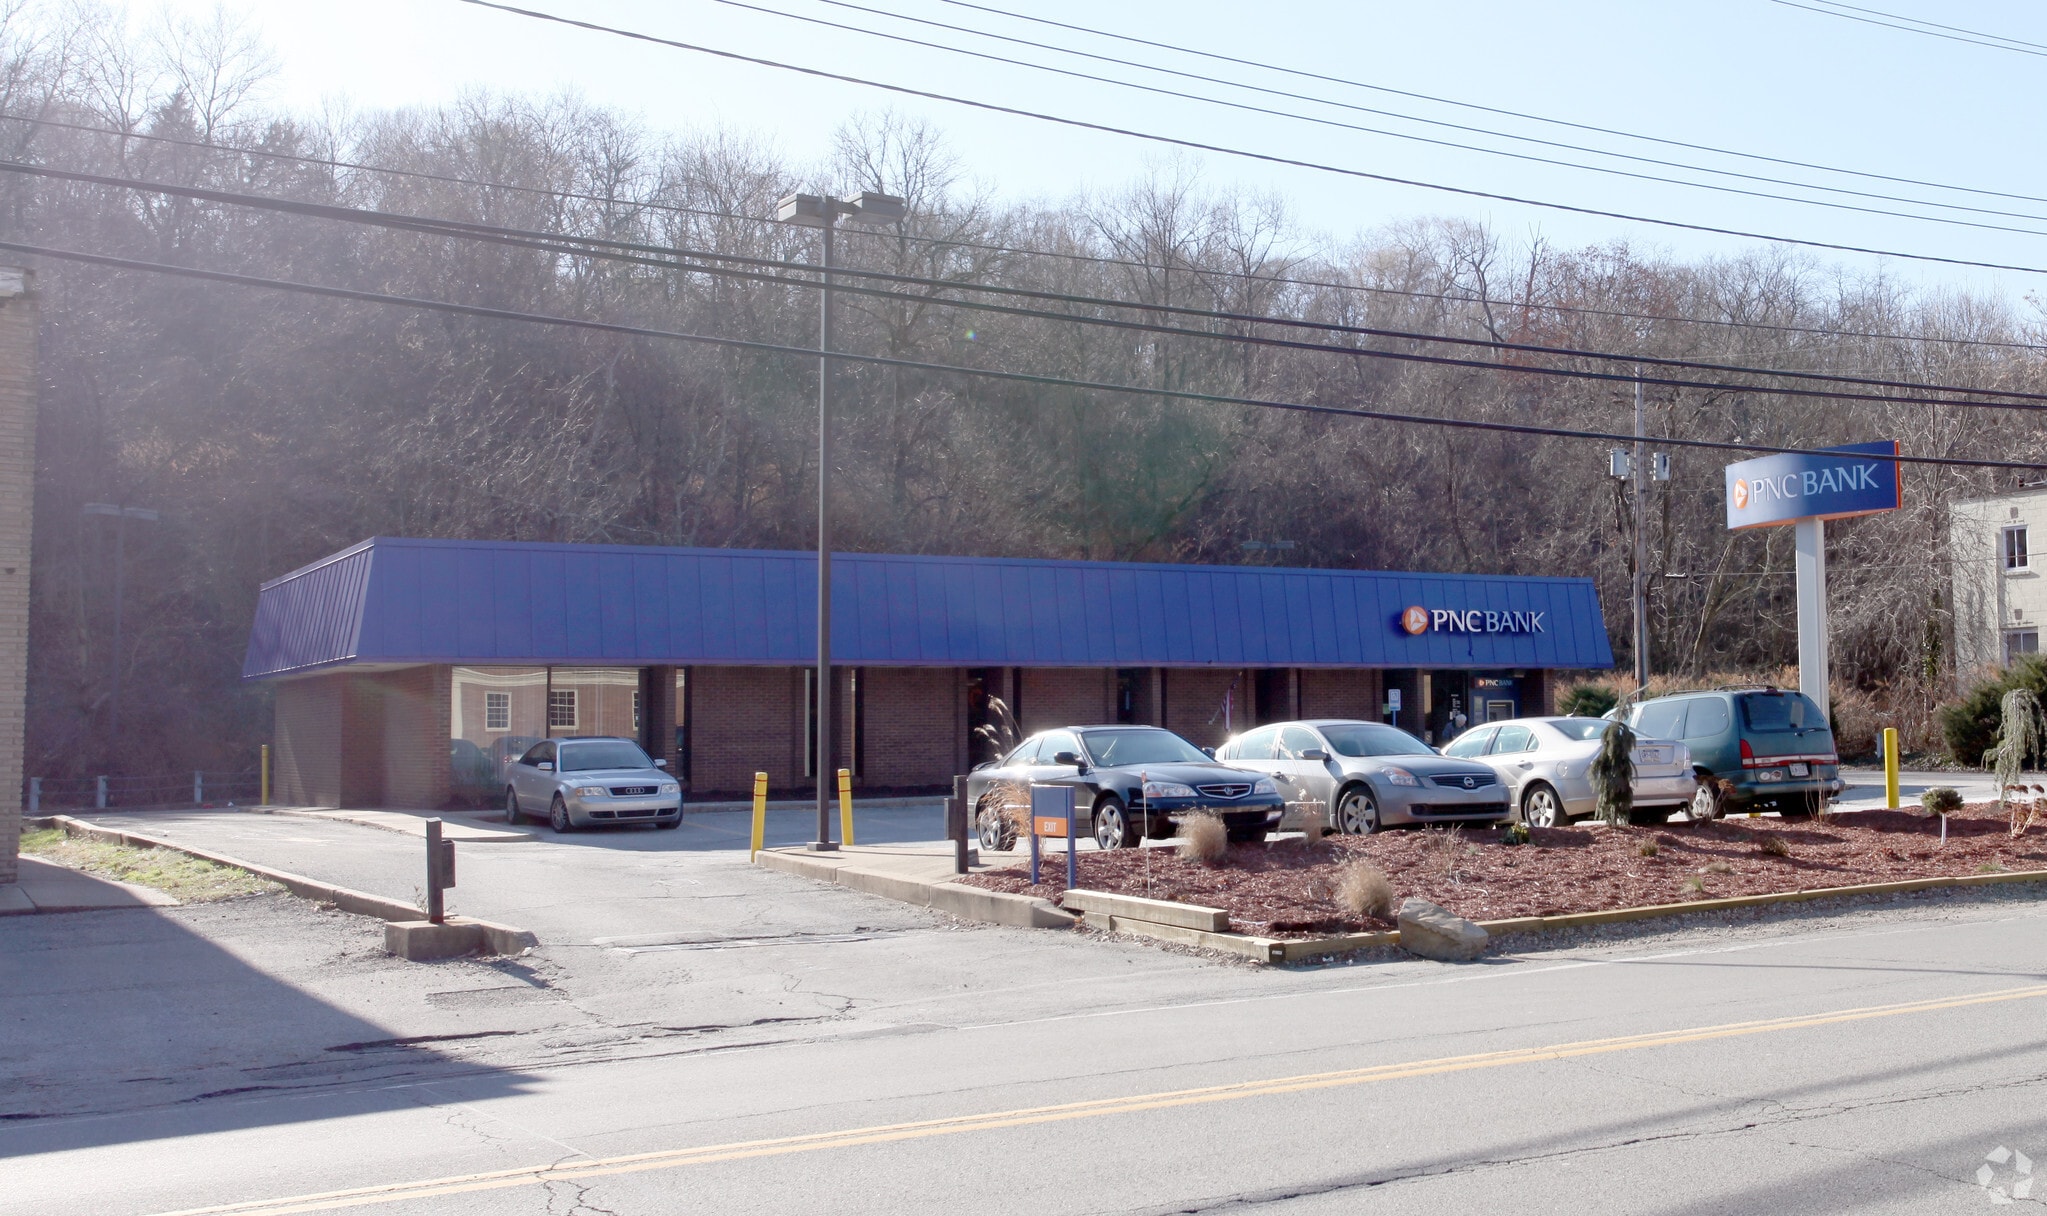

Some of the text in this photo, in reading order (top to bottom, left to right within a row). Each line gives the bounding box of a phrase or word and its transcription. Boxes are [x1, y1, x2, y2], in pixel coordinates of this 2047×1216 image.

[1751, 463, 1879, 504] PNC BANK
[1431, 609, 1545, 633] PNC BANK
[1485, 679, 1499, 687] PNC
[1044, 821, 1057, 833] EXIT
